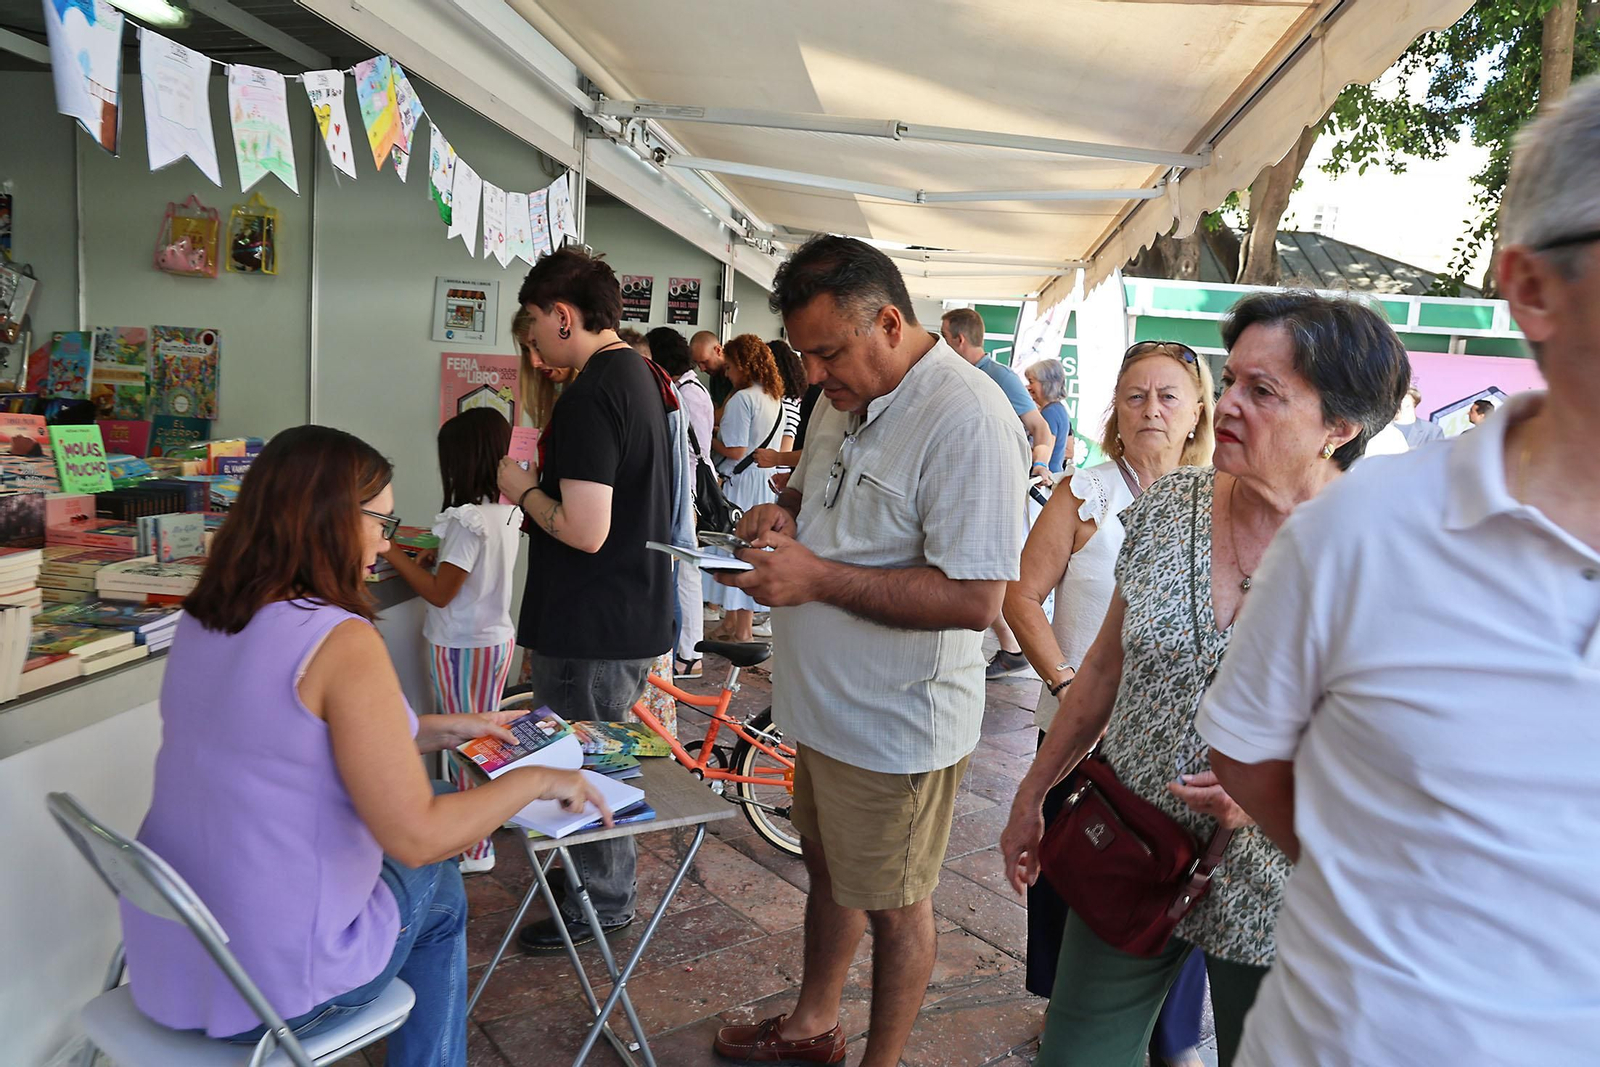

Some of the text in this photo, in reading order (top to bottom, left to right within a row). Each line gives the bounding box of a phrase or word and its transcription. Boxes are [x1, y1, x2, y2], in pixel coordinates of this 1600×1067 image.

[446, 357, 479, 371] FERIA
[467, 371, 500, 385] LIBRO
[501, 372, 517, 381] 2025
[173, 419, 186, 429] EL
[156, 427, 200, 439] CUERPO
